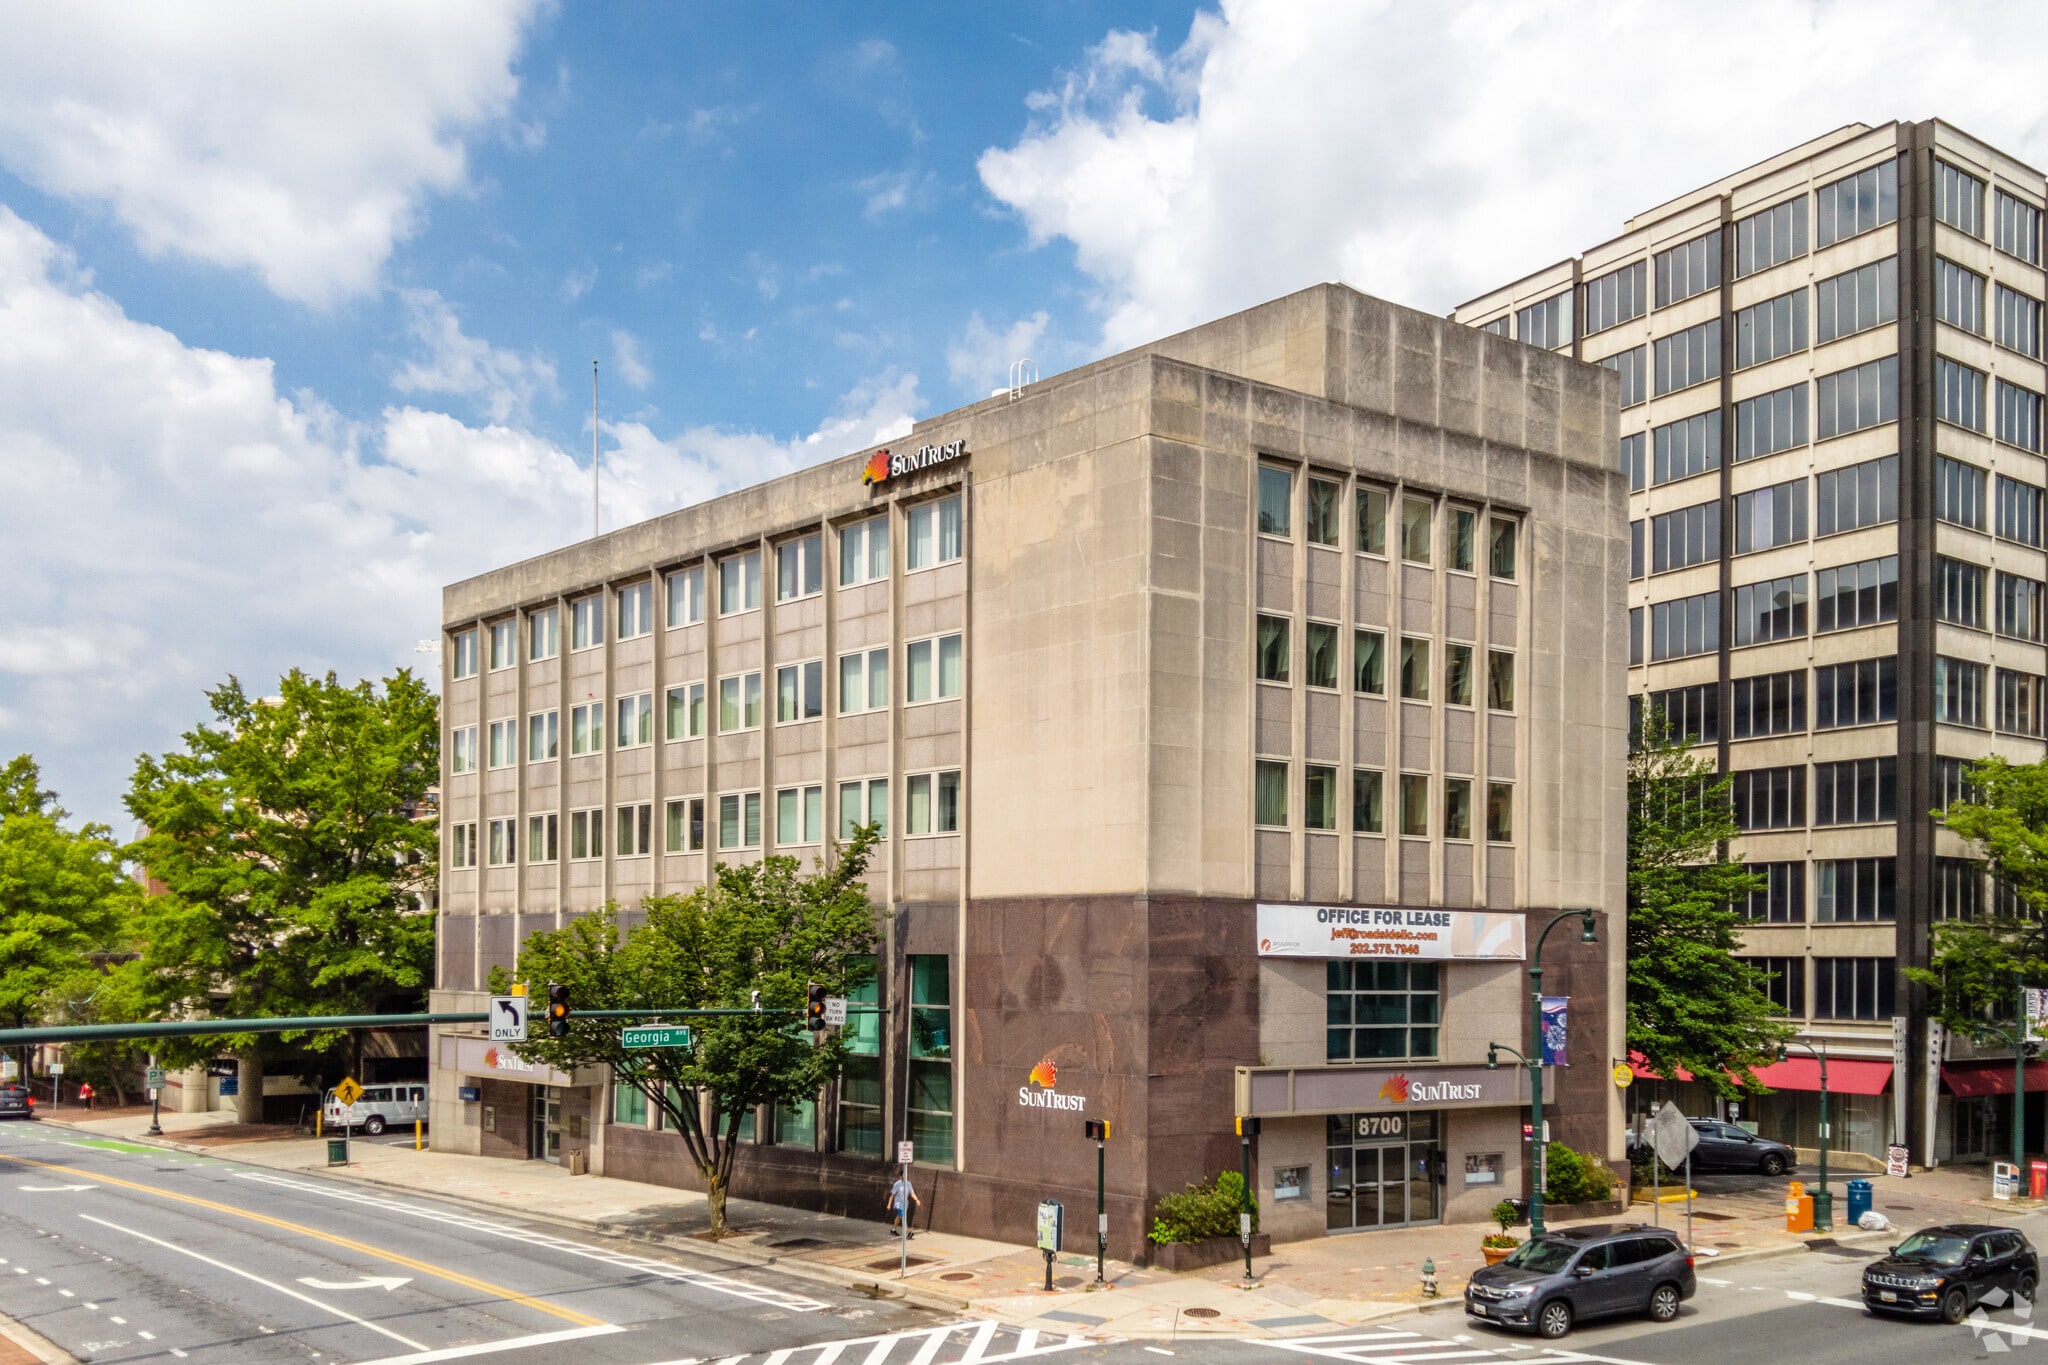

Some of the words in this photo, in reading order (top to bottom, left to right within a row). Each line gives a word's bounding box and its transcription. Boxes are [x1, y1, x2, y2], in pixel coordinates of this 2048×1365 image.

[1316, 908, 1370, 924] OFFICE
[1374, 910, 1402, 925] FOR
[1406, 911, 1451, 927] LEASE
[495, 1028, 521, 1038] ONLY
[625, 1031, 670, 1045] Georgia
[1358, 1116, 1402, 1136] 8700
